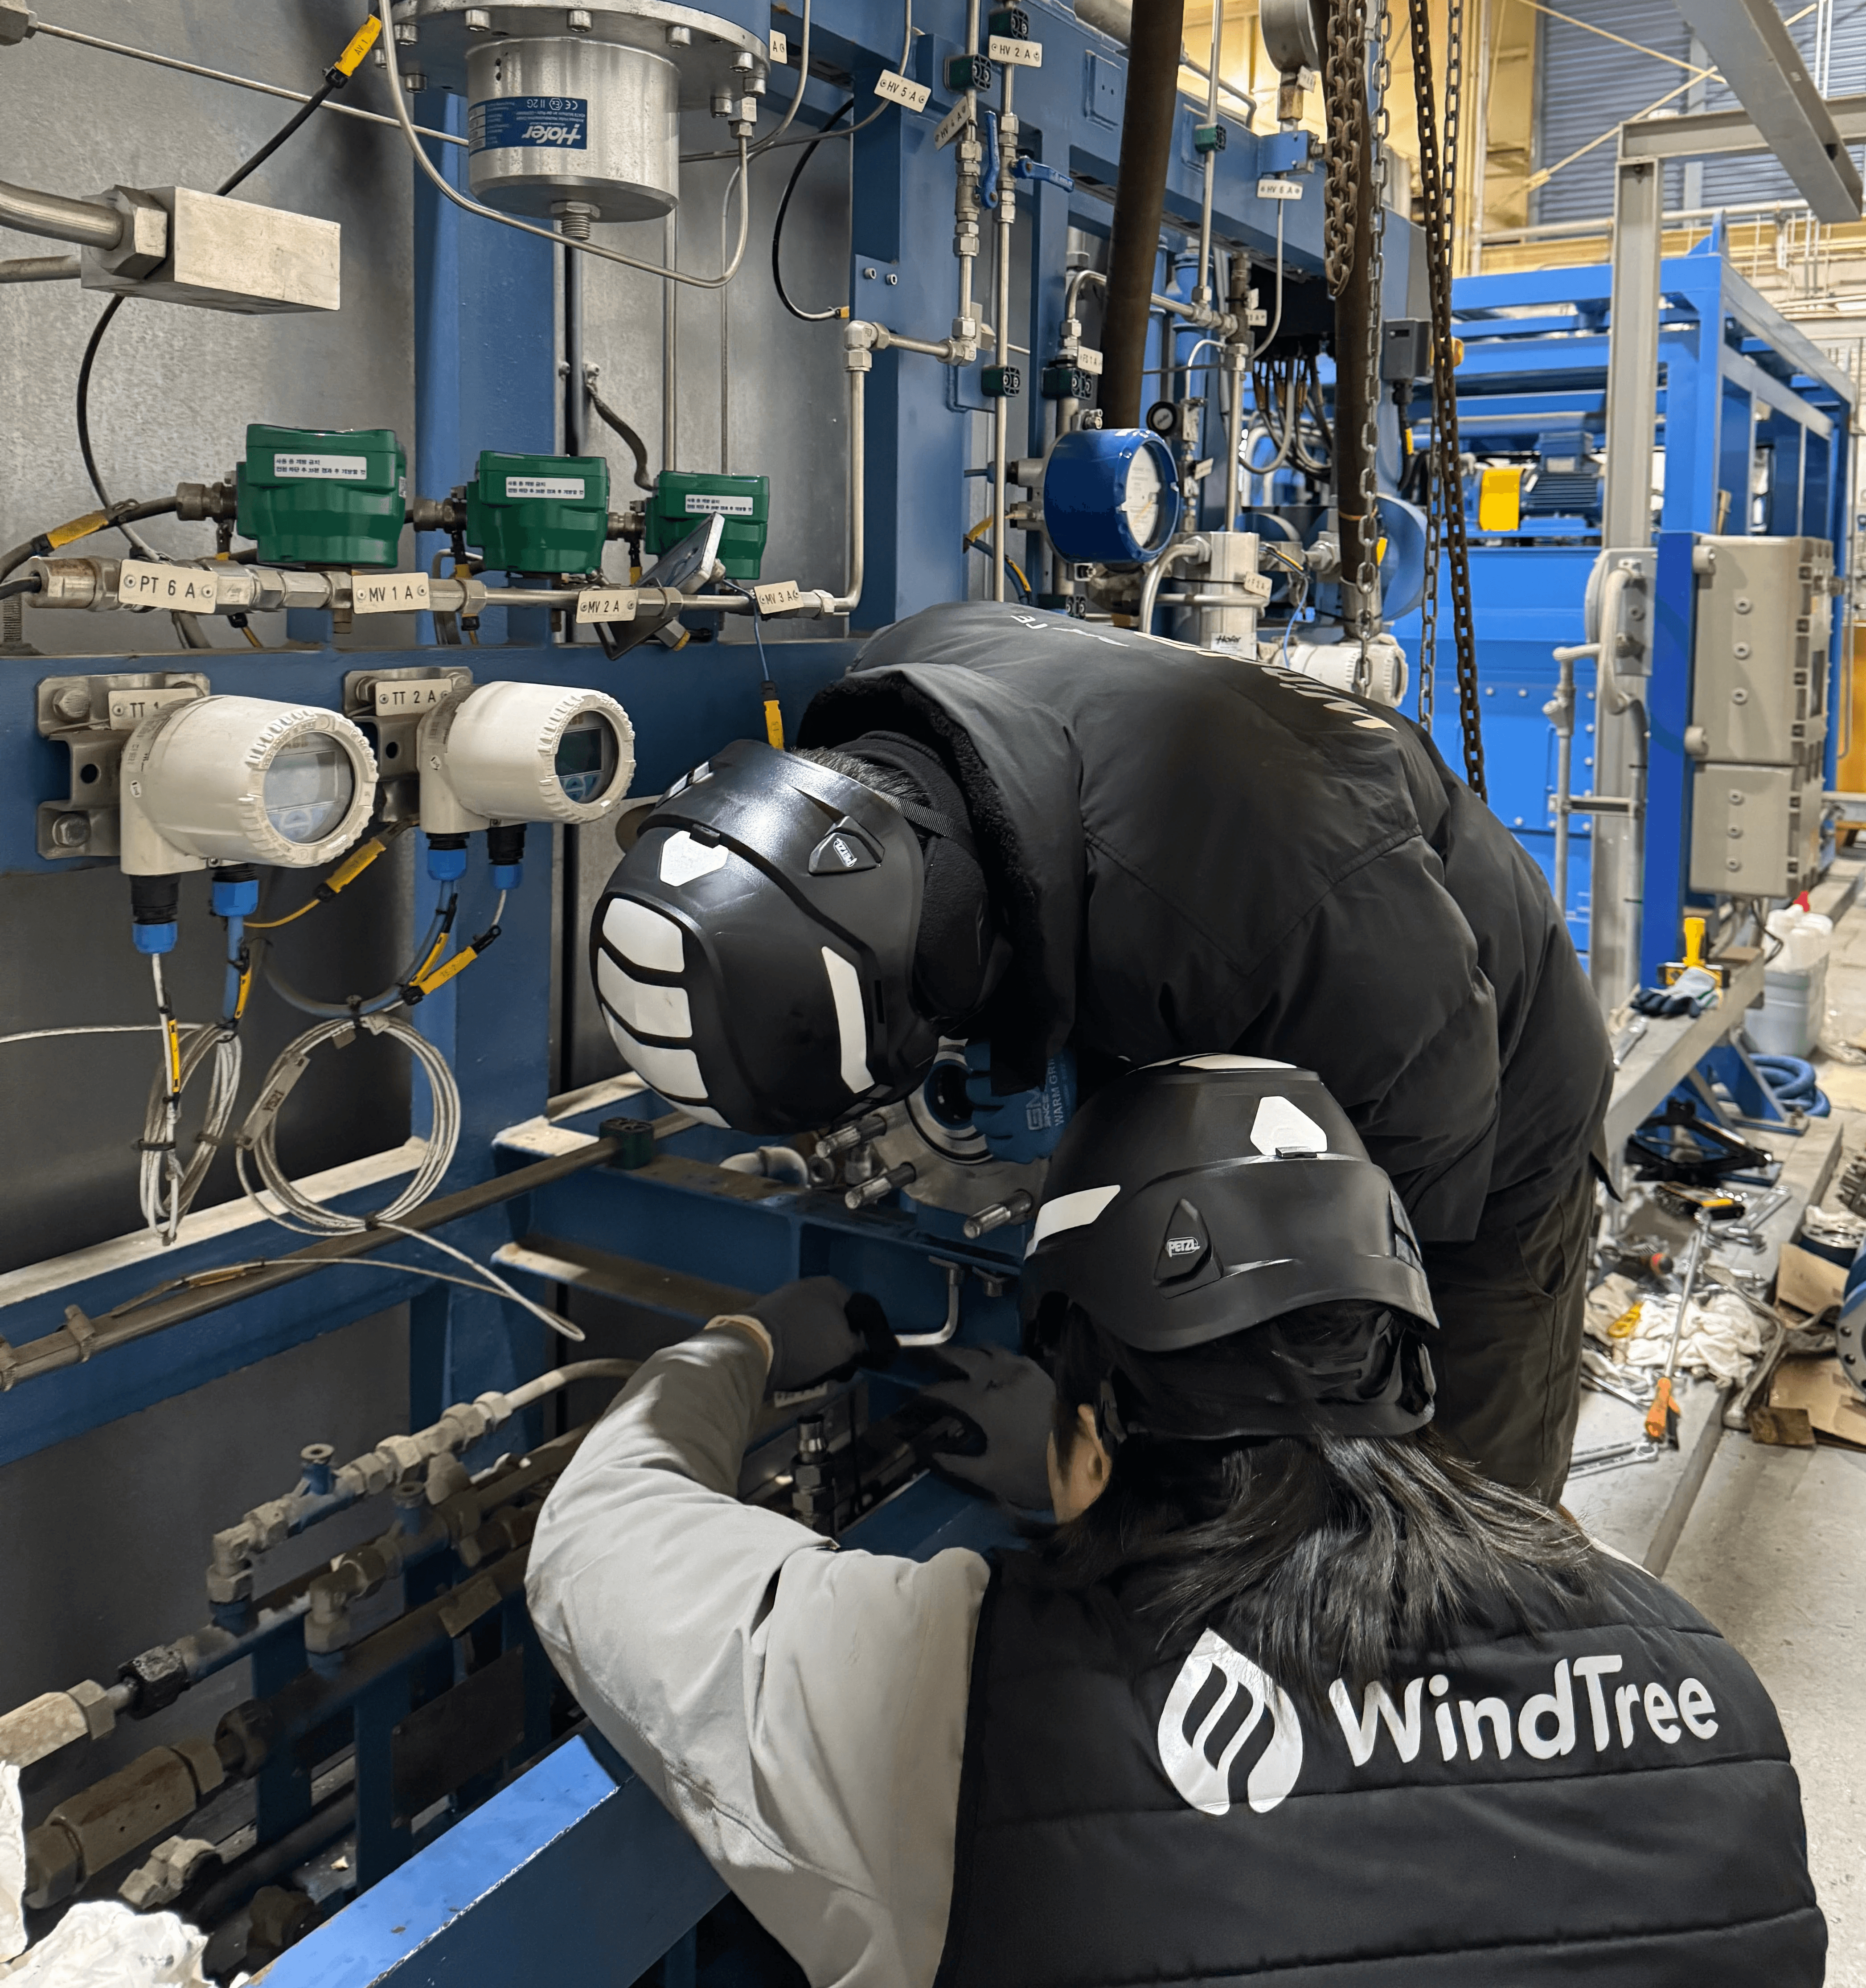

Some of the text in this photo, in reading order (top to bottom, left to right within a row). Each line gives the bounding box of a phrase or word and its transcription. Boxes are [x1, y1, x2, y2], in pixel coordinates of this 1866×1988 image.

[353, 45, 364, 56] AV
[773, 41, 778, 53] A
[1000, 45, 1030, 58] HV 2 A
[886, 81, 916, 102] HV 5 A
[522, 124, 581, 145] Hofer
[140, 575, 195, 598] PT 6 A
[369, 585, 413, 602] MV 1 A
[765, 590, 793, 604] MV 3 A
[588, 600, 619, 613] MV 2 A
[392, 690, 436, 705] TT 2 A
[129, 702, 145, 717] TT
[1051, 1086, 1065, 1127] WARM
[1168, 1238, 1200, 1258] PETZL
[1329, 1654, 1719, 1767] WindTree
